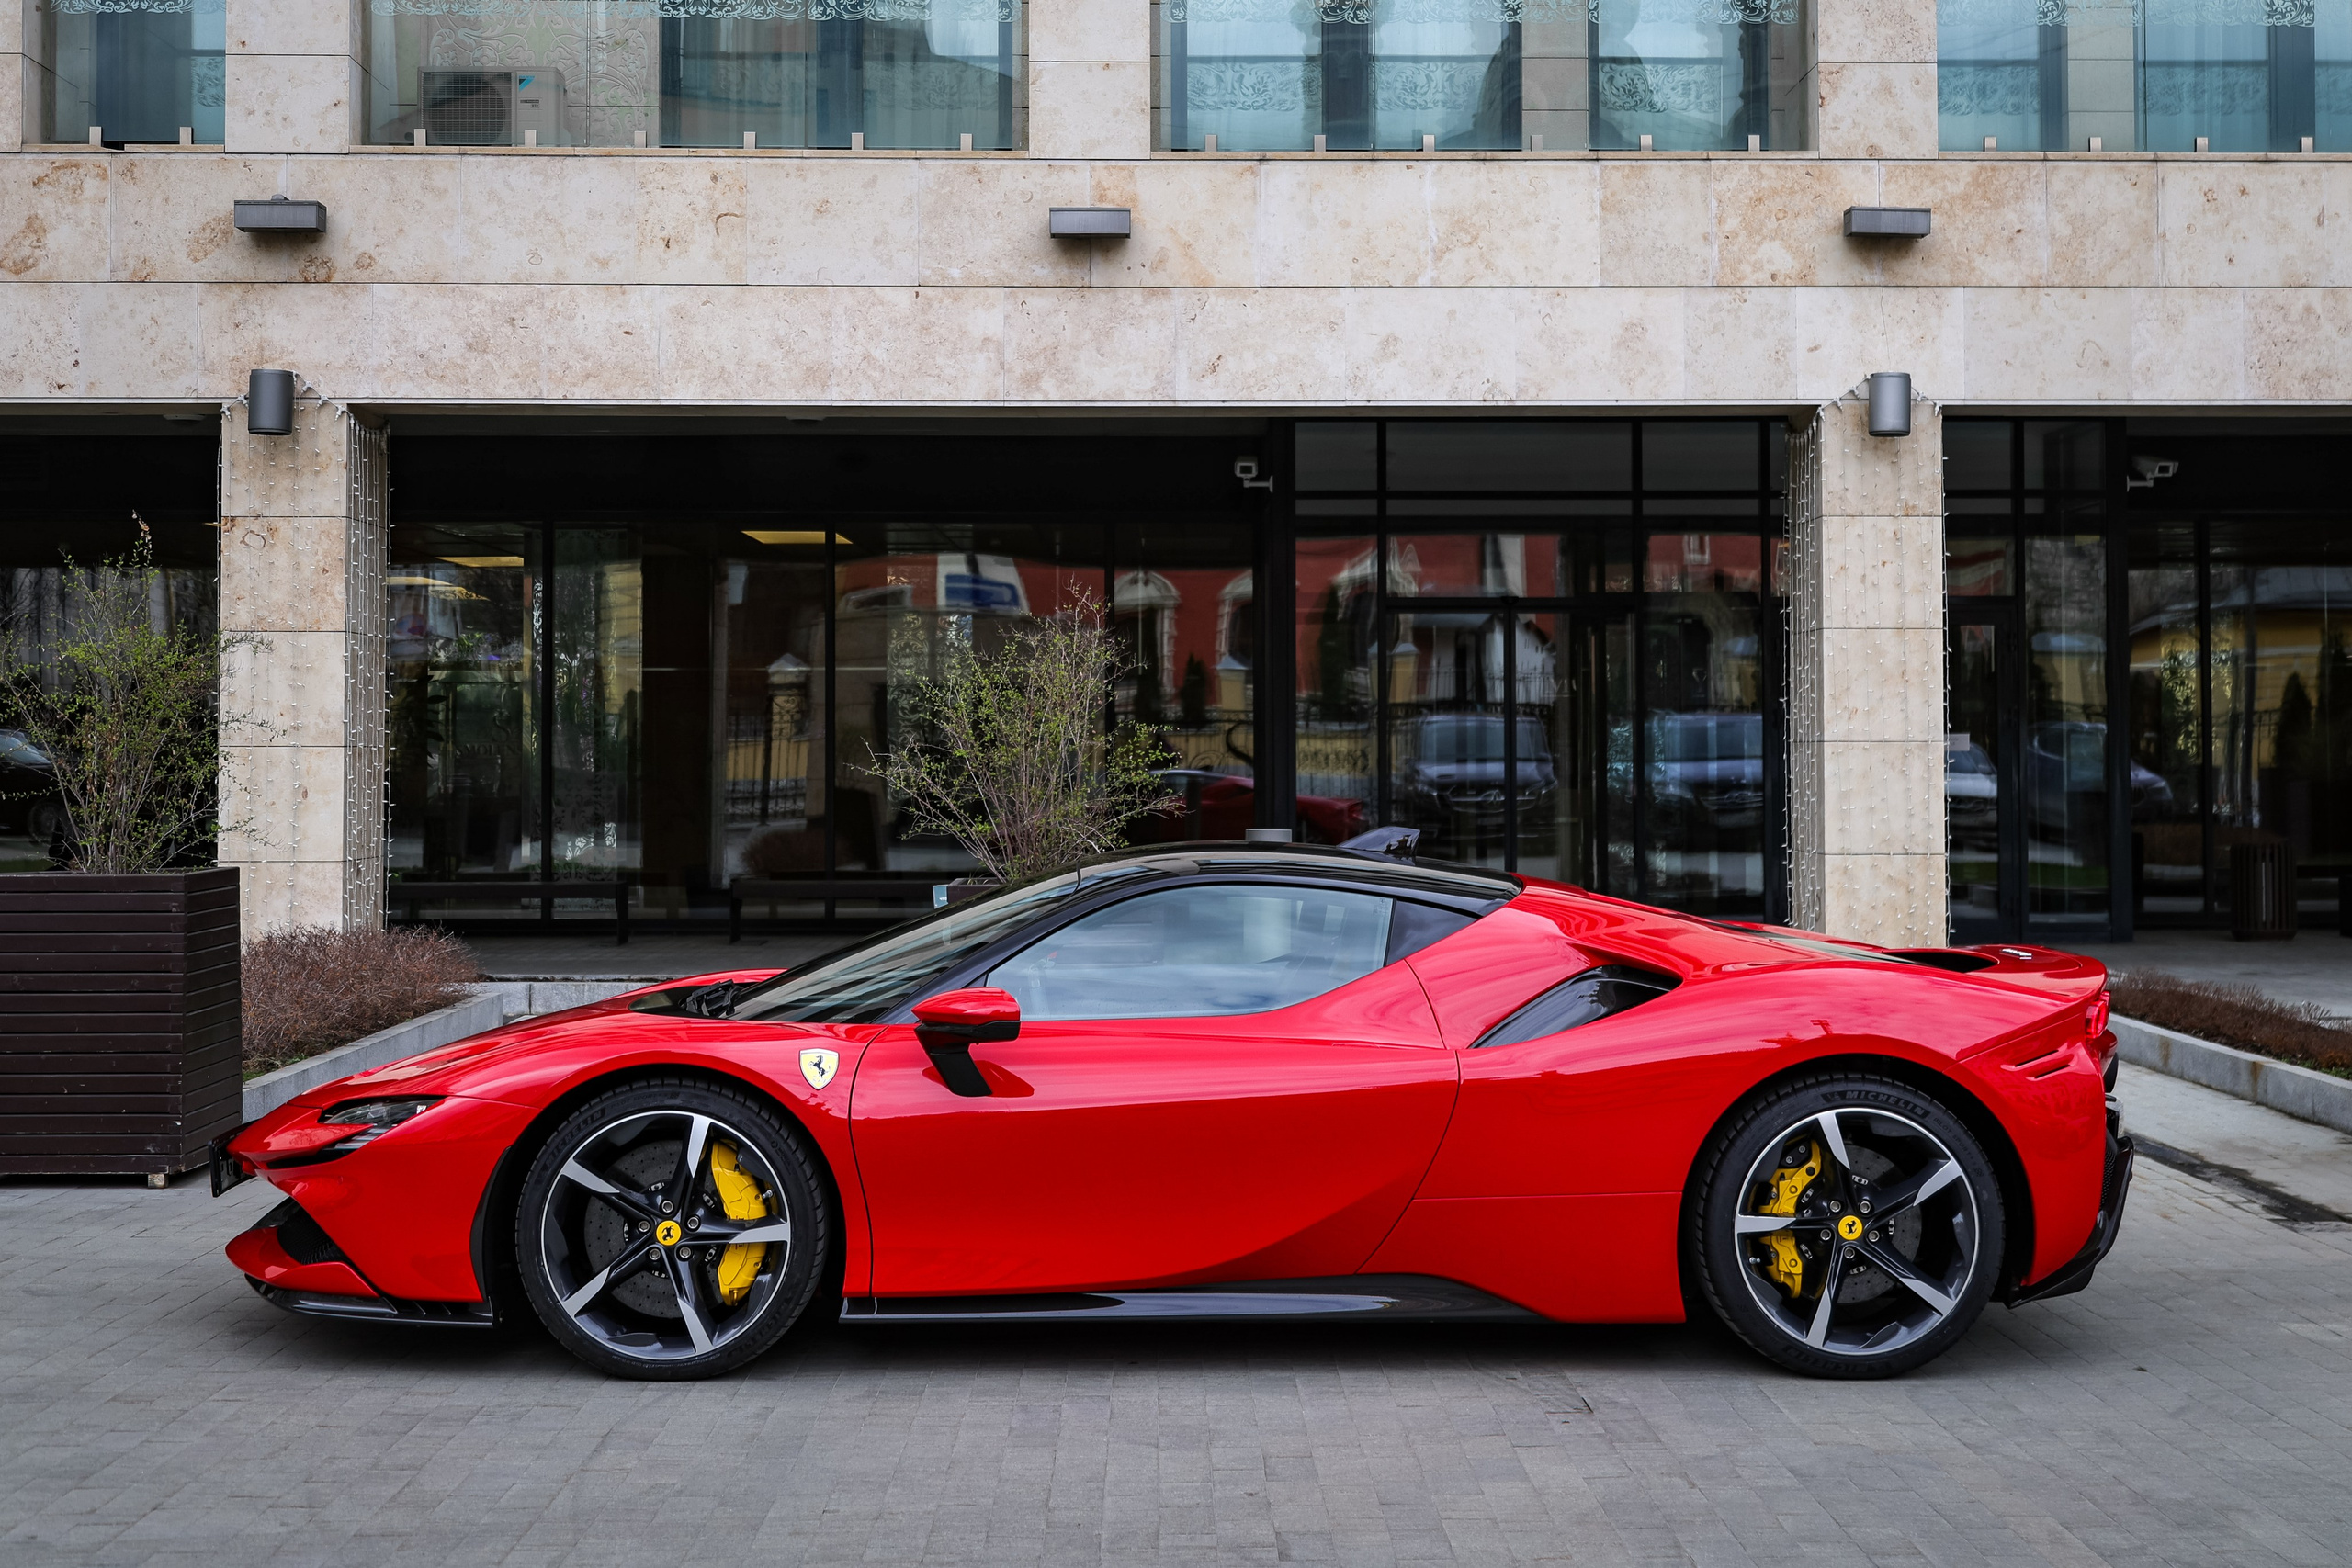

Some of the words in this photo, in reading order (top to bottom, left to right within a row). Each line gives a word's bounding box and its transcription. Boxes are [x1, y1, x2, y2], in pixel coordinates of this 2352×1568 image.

[1844, 1090, 1926, 1116] MICHELIN
[545, 1110, 603, 1167] MICHELIN
[1933, 1117, 1952, 1134] PILOT
